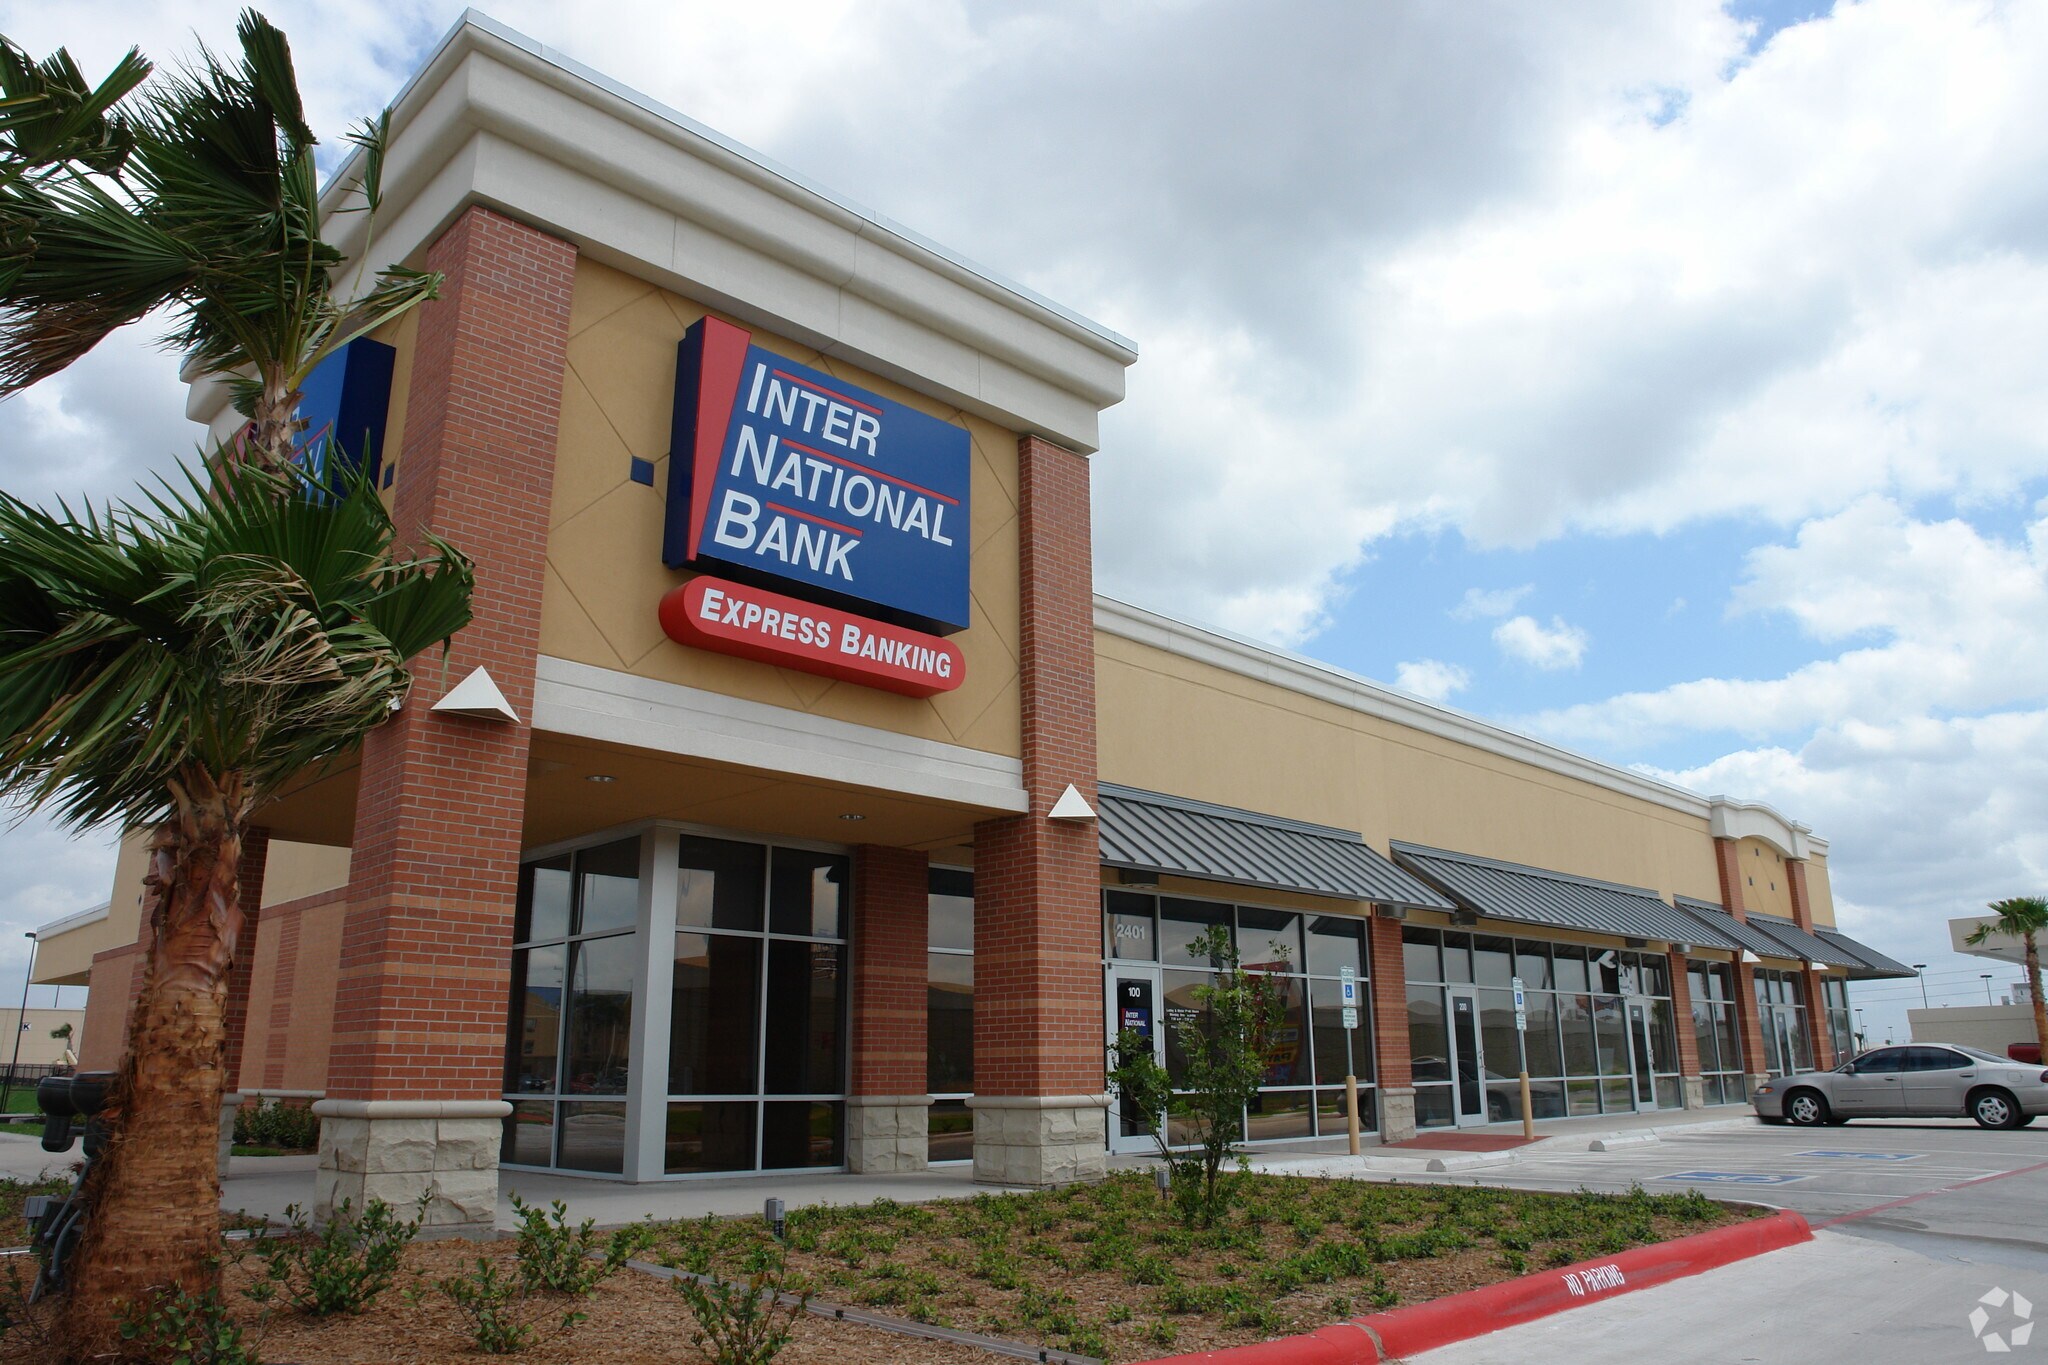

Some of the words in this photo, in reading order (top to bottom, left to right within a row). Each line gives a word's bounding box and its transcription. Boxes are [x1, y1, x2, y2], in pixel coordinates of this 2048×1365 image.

[747, 363, 881, 456] INTER
[730, 424, 953, 546] NATIONAL
[714, 489, 860, 581] BANK
[700, 588, 831, 648] EXPRESS
[840, 624, 951, 678] BANKING
[1117, 924, 1145, 939] 2401
[1128, 987, 1141, 997] 100
[1125, 1010, 1139, 1019] INTER
[1125, 1019, 1146, 1027] NATIONAL
[1561, 1273, 1584, 1296] NO
[1579, 1264, 1624, 1291] PARKING
